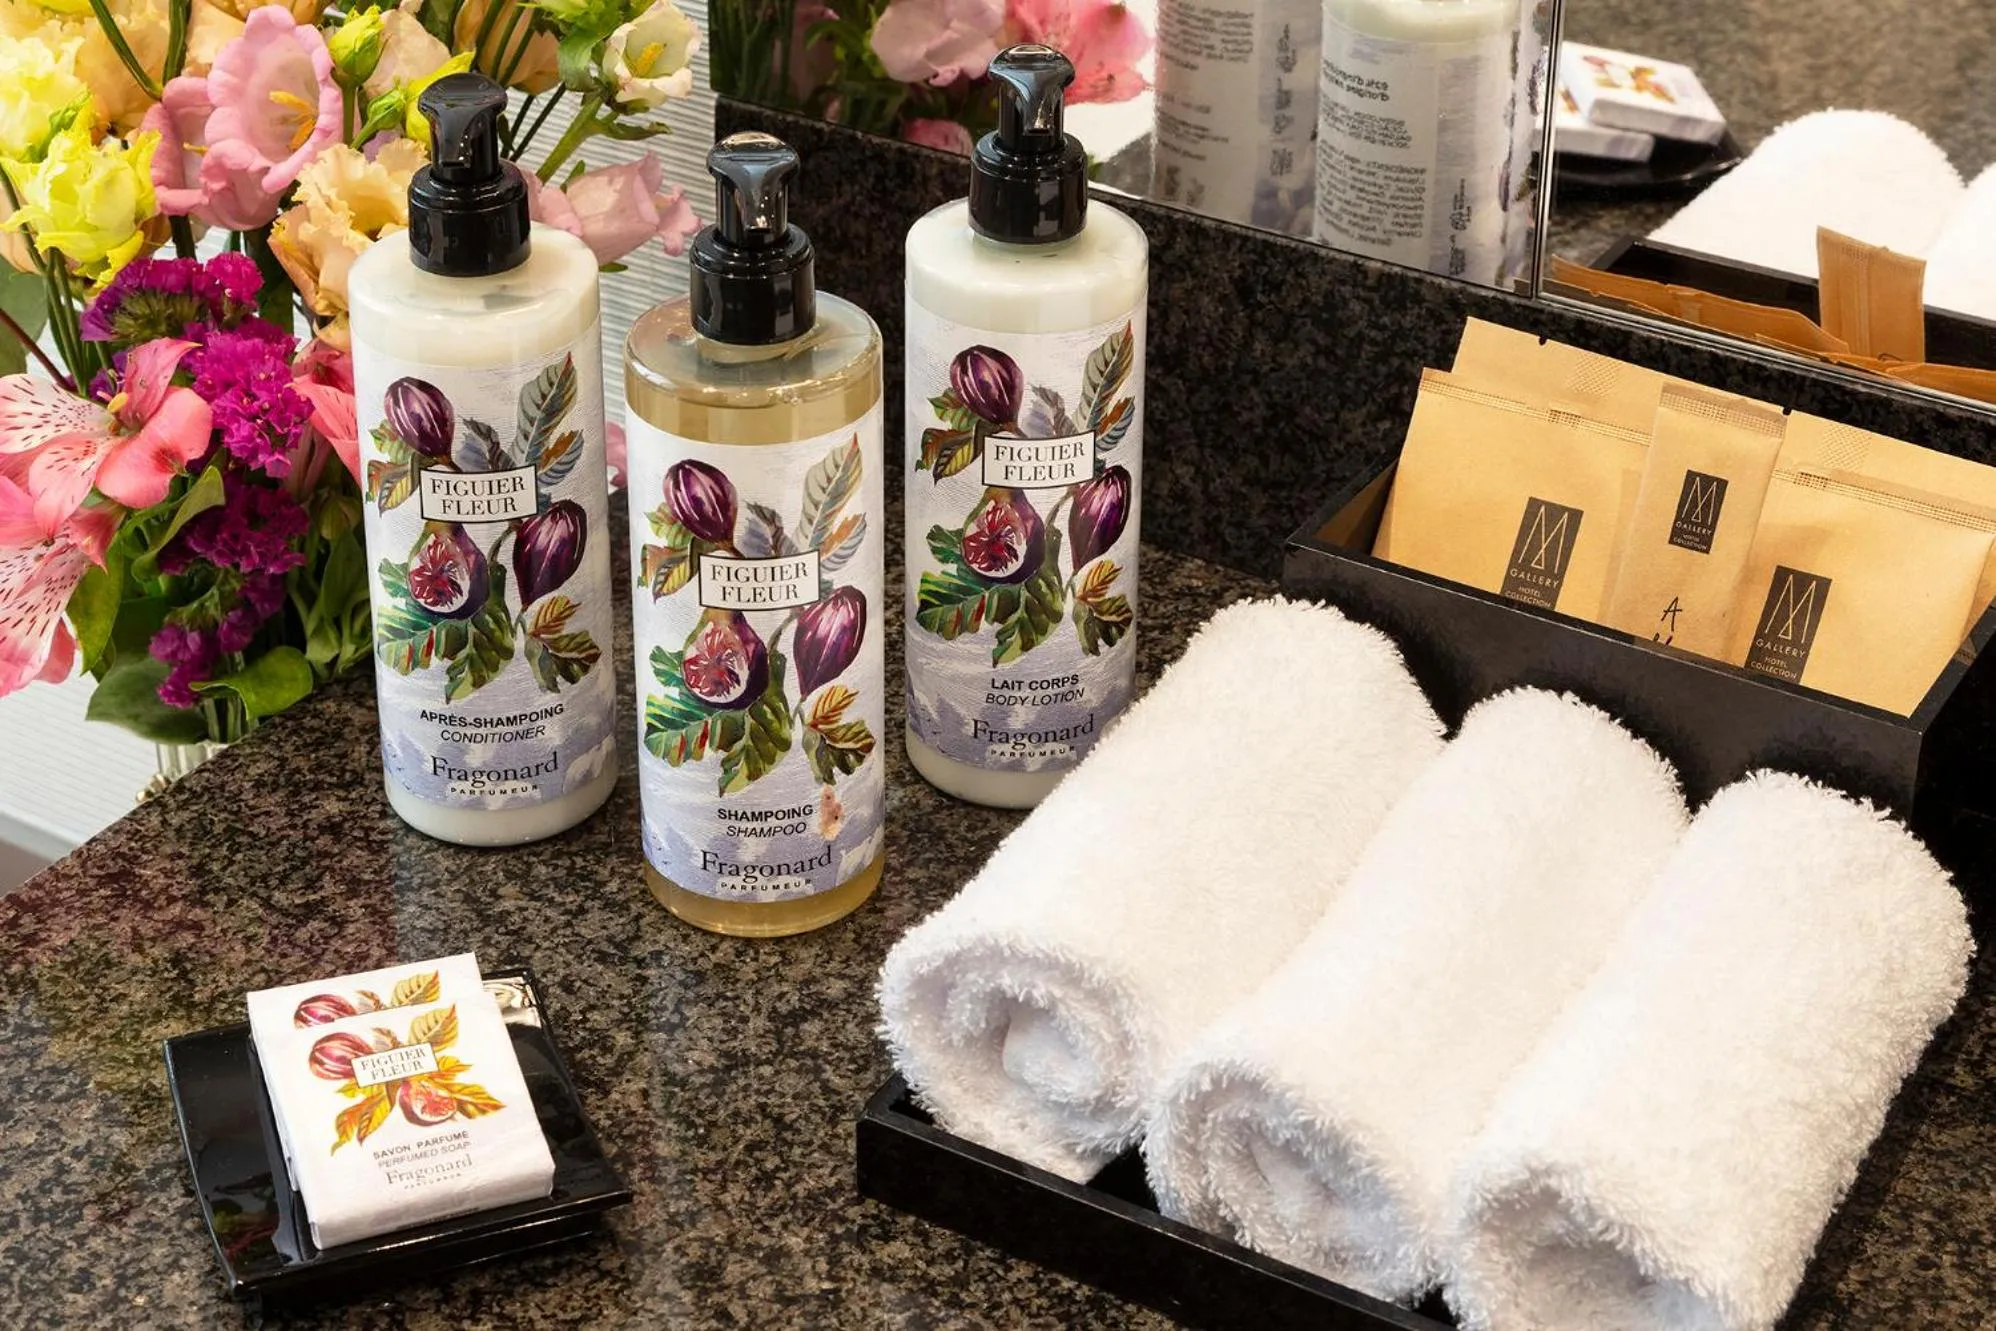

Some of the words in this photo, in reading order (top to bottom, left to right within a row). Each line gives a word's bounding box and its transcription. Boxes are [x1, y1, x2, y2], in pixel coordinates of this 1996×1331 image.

[994, 441, 1086, 462] FIGUIER
[1003, 462, 1076, 482] FLEUR
[430, 475, 526, 497] FIGUIER
[440, 496, 518, 516] FLEUR
[711, 561, 809, 583] FIGUIER
[1509, 567, 1560, 589] GALLERY
[721, 583, 800, 603] FLEUR
[1755, 638, 1807, 658] GALLERY
[1750, 660, 1798, 680] COLLECTION
[991, 677, 1024, 690] LAIT
[1028, 674, 1079, 690] CORPS
[985, 693, 1028, 706] BODY
[1031, 687, 1085, 706] LOTION
[440, 725, 546, 744] CONDITIONER
[972, 713, 1095, 751] Fragonard
[990, 745, 1075, 758] PARFUMEUR
[430, 751, 559, 789] Fragonard
[450, 785, 539, 796] PARFUMEUR
[717, 804, 814, 822] SHAMPOING
[726, 822, 807, 838] SHAMPOO
[700, 845, 832, 884] Fragonard
[720, 879, 812, 892] PARFUMEUR
[361, 1047, 426, 1071] FIGUIER
[370, 1060, 424, 1081] FLEUR
[373, 1144, 411, 1160] SAVON
[385, 1153, 473, 1185] Fragonard
